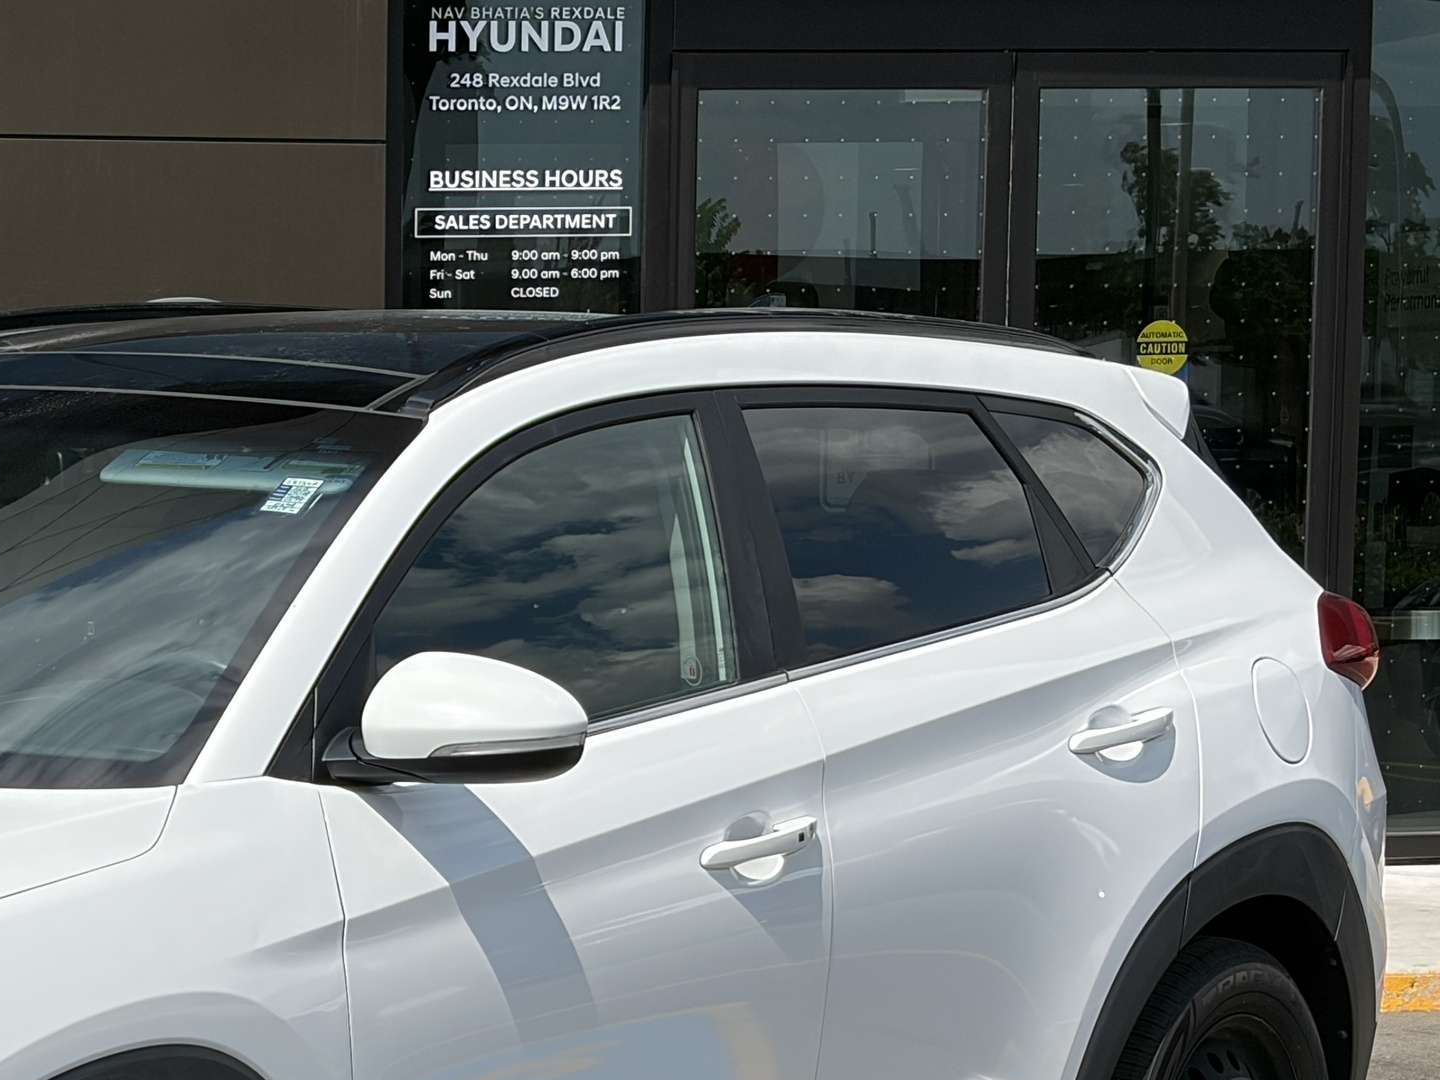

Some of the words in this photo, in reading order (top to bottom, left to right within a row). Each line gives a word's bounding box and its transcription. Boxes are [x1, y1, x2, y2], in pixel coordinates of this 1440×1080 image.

[431, 7, 465, 19] NAV
[470, 7, 544, 19] BHATIA'S
[550, 7, 625, 20] REXDALE
[429, 20, 623, 52] HYUNDAI
[450, 72, 484, 88] 248
[488, 72, 559, 88] Rexdale
[563, 72, 601, 87] Blvd
[429, 95, 502, 113] Toronto,
[505, 95, 539, 113] ON,
[541, 95, 588, 111] M9W
[591, 95, 621, 110] 1R2
[430, 170, 539, 188] BUSINESS
[544, 169, 623, 187] HOURS
[434, 214, 491, 230] SALES
[495, 213, 617, 229] DEPARTMENT
[430, 251, 456, 261] Mon
[466, 250, 488, 261] Thu
[511, 250, 539, 261] 9:00
[540, 252, 561, 261] am
[571, 249, 598, 260] 9:00
[600, 251, 620, 263] pm
[429, 269, 445, 280] Fri
[455, 269, 475, 280] Sat
[540, 271, 560, 280] am
[570, 268, 598, 279] 6:00
[599, 270, 620, 281] pm
[429, 288, 452, 299] Sun
[510, 287, 560, 298] CLOSED
[1140, 342, 1186, 354] CAUTION
[1150, 357, 1173, 365] DOOR
